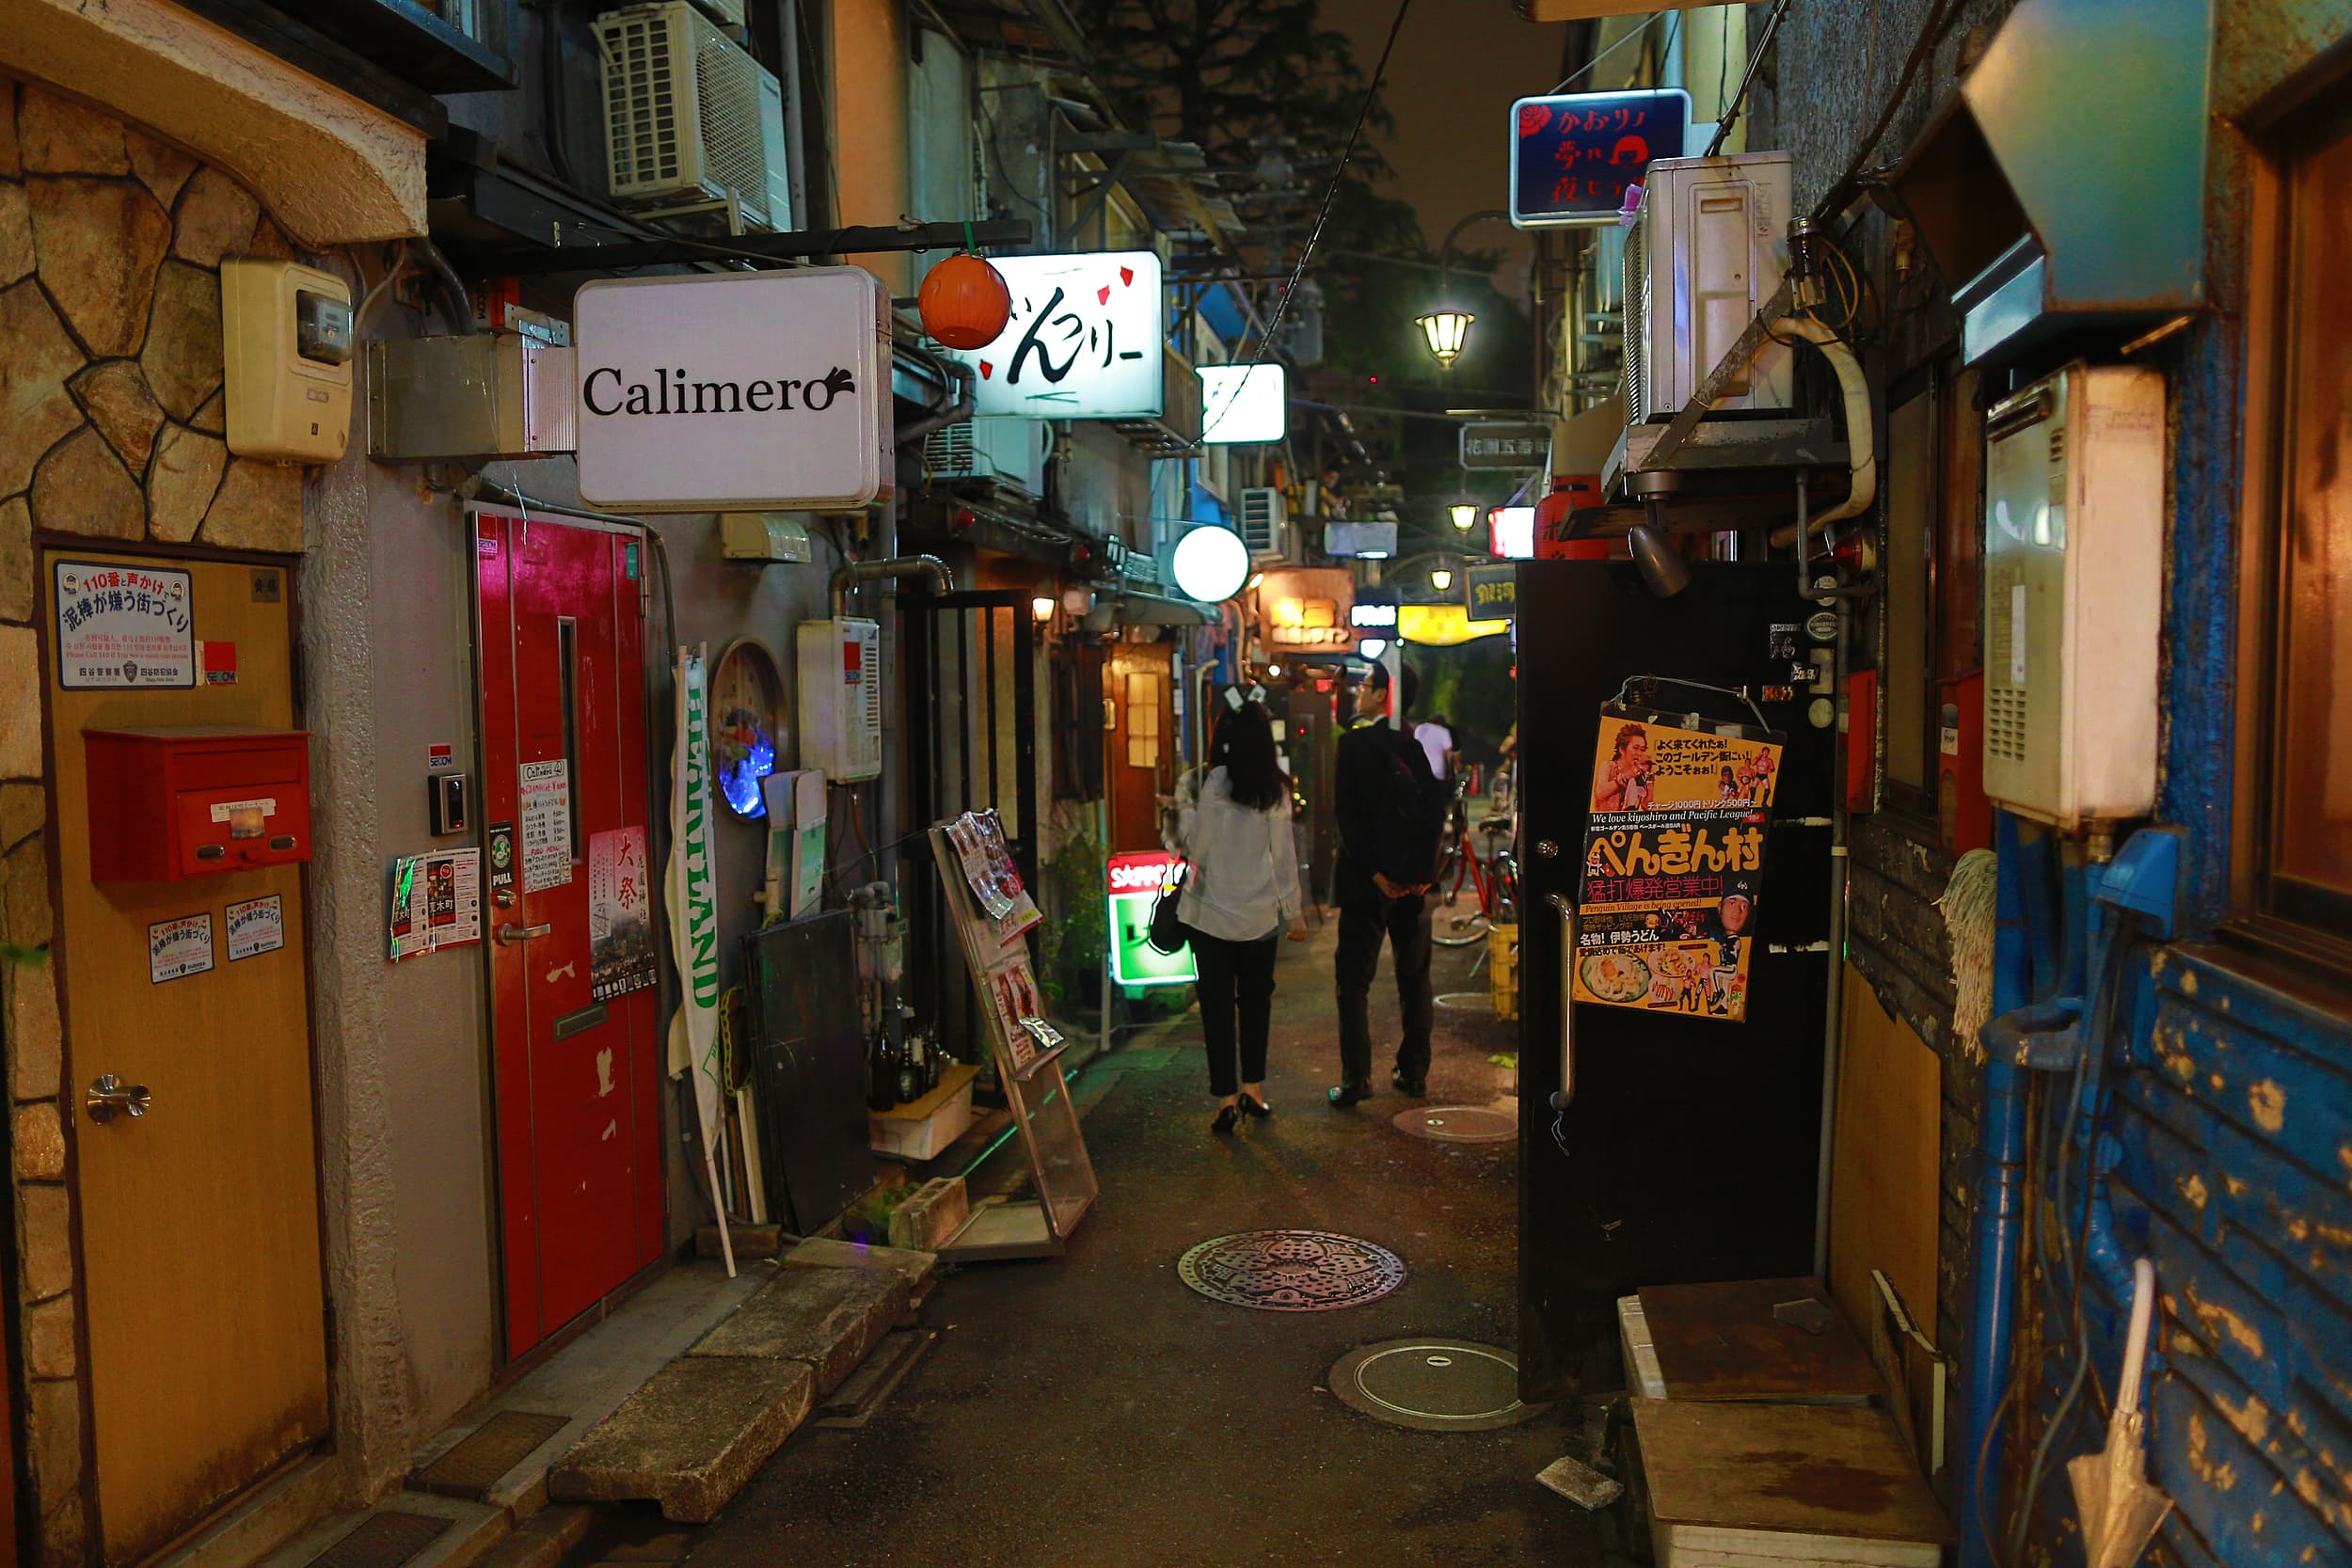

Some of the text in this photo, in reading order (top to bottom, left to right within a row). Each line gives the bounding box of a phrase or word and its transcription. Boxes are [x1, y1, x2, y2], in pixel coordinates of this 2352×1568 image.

[582, 368, 836, 417] Calimero
[62, 591, 189, 633] 泥棒が嫌う街づくり
[430, 756, 452, 767] SECOM
[1593, 808, 1753, 824] We love kiyoshiro and Pacific League!
[1588, 823, 1764, 877] ぺんぎん村
[493, 873, 512, 886] PULL
[617, 833, 637, 911] 大祭
[1587, 875, 1724, 903] 猛打爆発営業中!
[1585, 905, 1615, 914] Penguin
[1617, 902, 1643, 912] Village
[1651, 901, 1672, 911] being
[1581, 929, 1660, 946] 名物! 伊勢うどん
